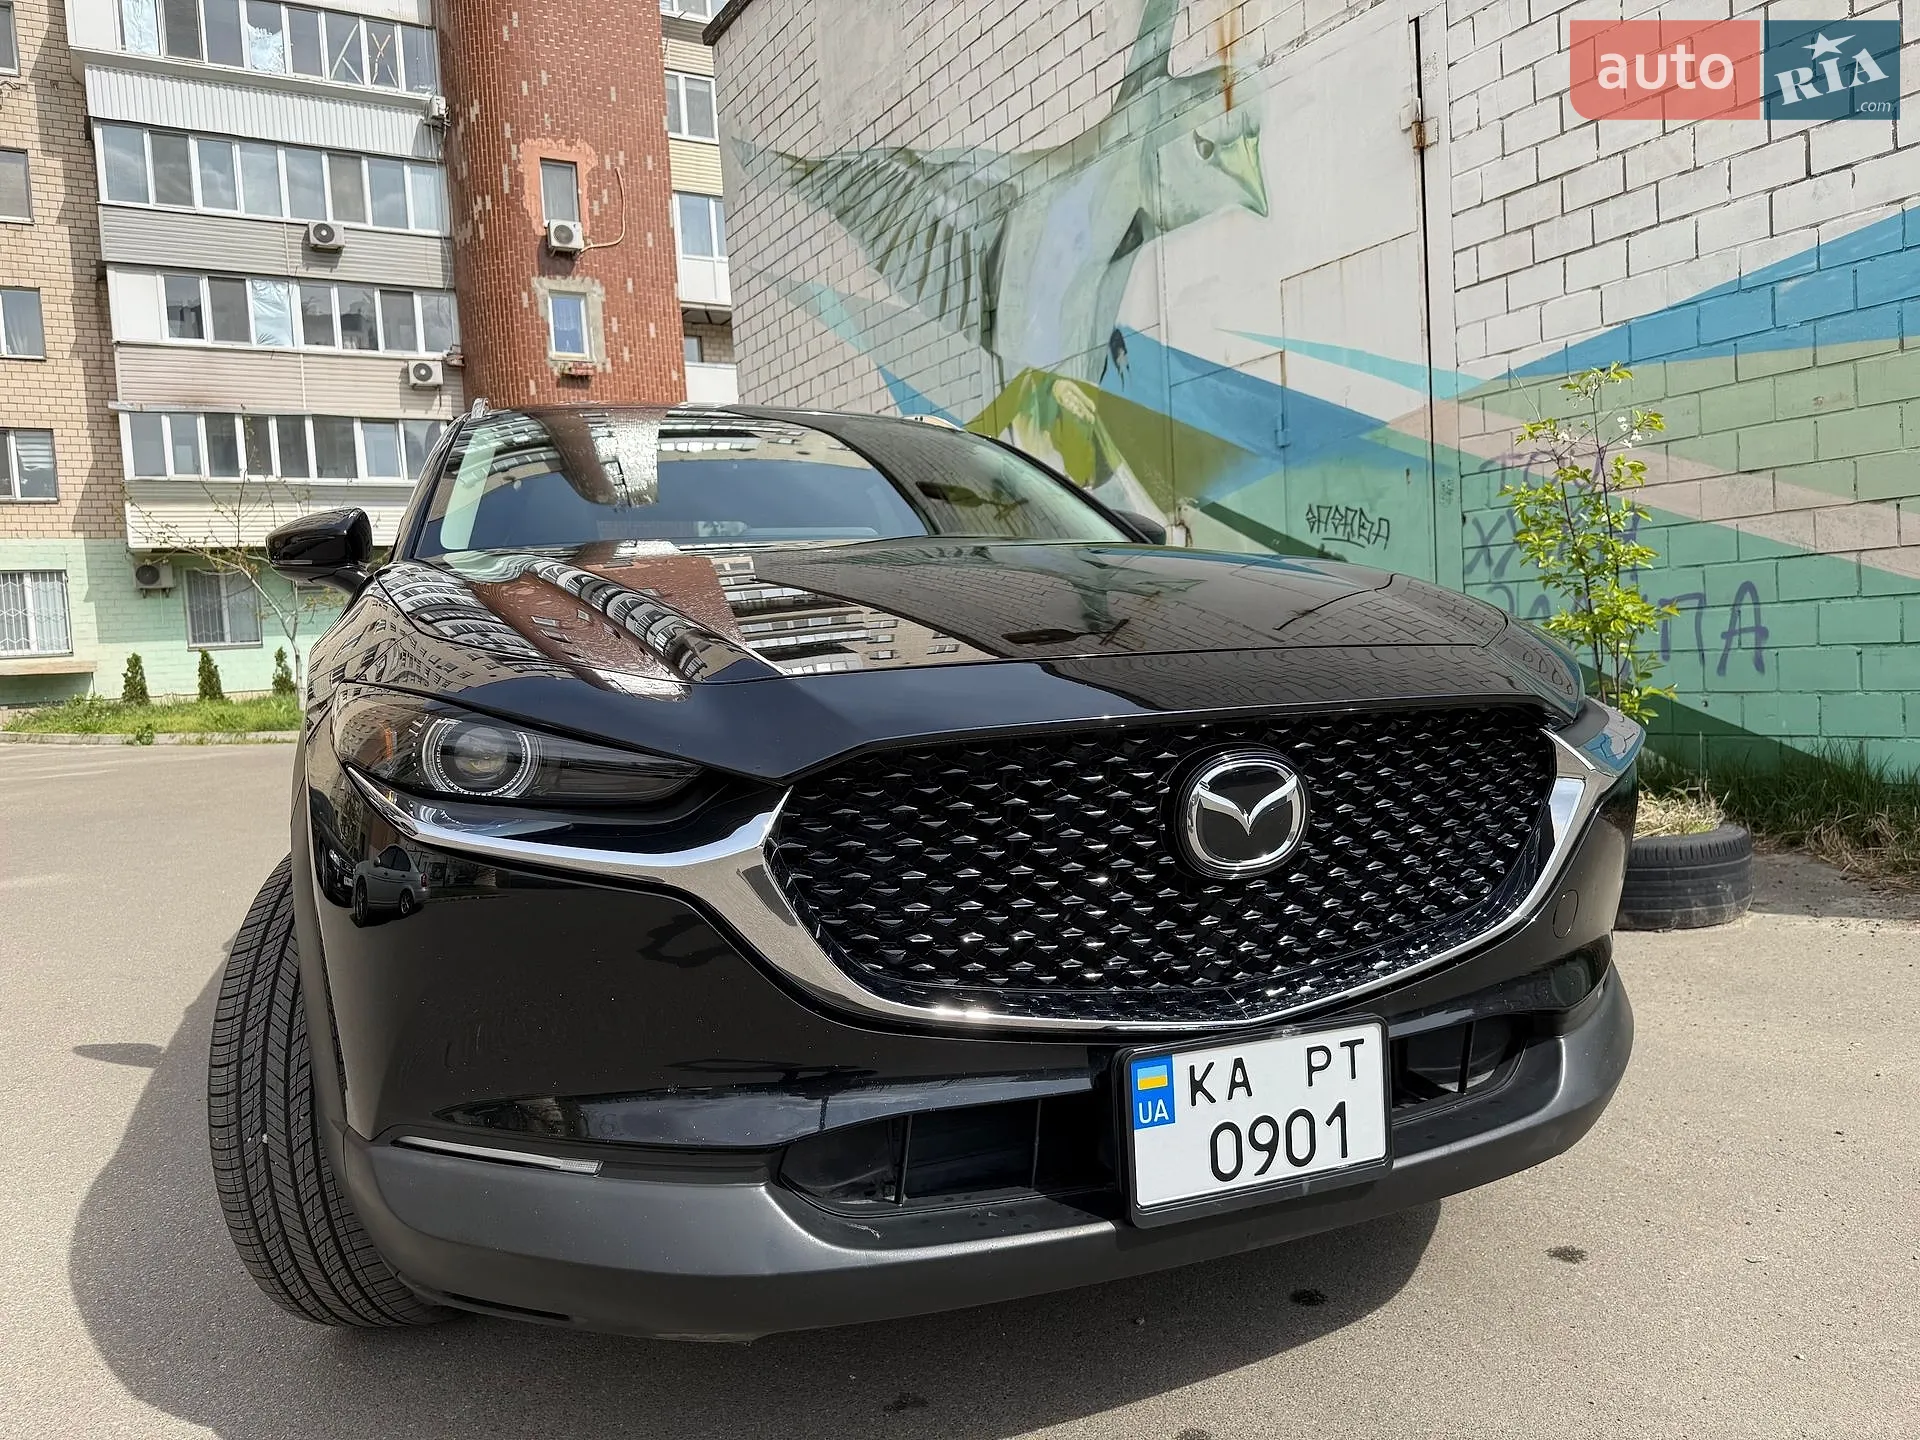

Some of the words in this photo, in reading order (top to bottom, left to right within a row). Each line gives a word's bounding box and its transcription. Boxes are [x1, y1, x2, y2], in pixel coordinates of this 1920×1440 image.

[1189, 1057, 1252, 1106] KA
[1306, 1038, 1365, 1087] PT
[1138, 1098, 1169, 1124] UA
[1209, 1100, 1348, 1182] 0901
